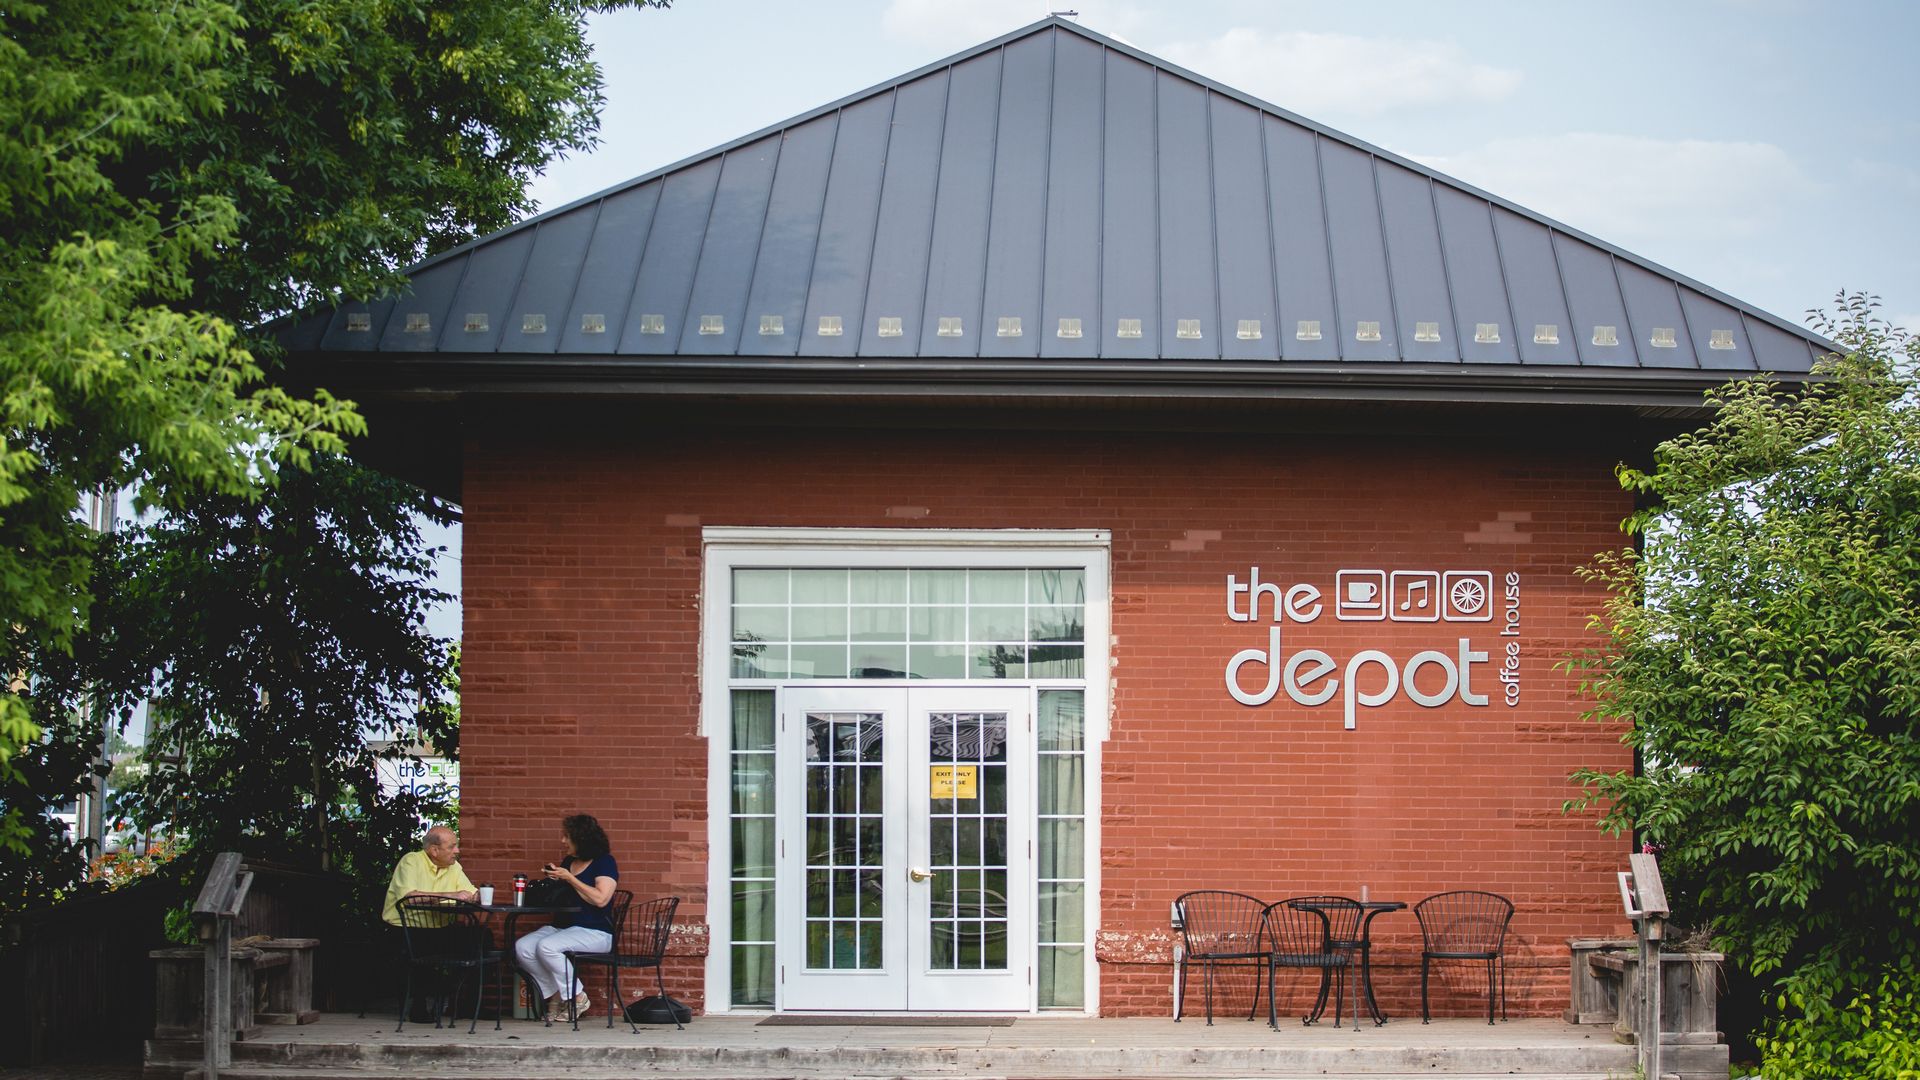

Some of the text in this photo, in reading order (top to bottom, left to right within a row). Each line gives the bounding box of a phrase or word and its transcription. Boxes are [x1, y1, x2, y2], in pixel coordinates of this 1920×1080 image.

[1227, 567, 1323, 622] the
[1225, 626, 1489, 730] depot
[1500, 571, 1520, 706] coffee house
[400, 762, 425, 777] the
